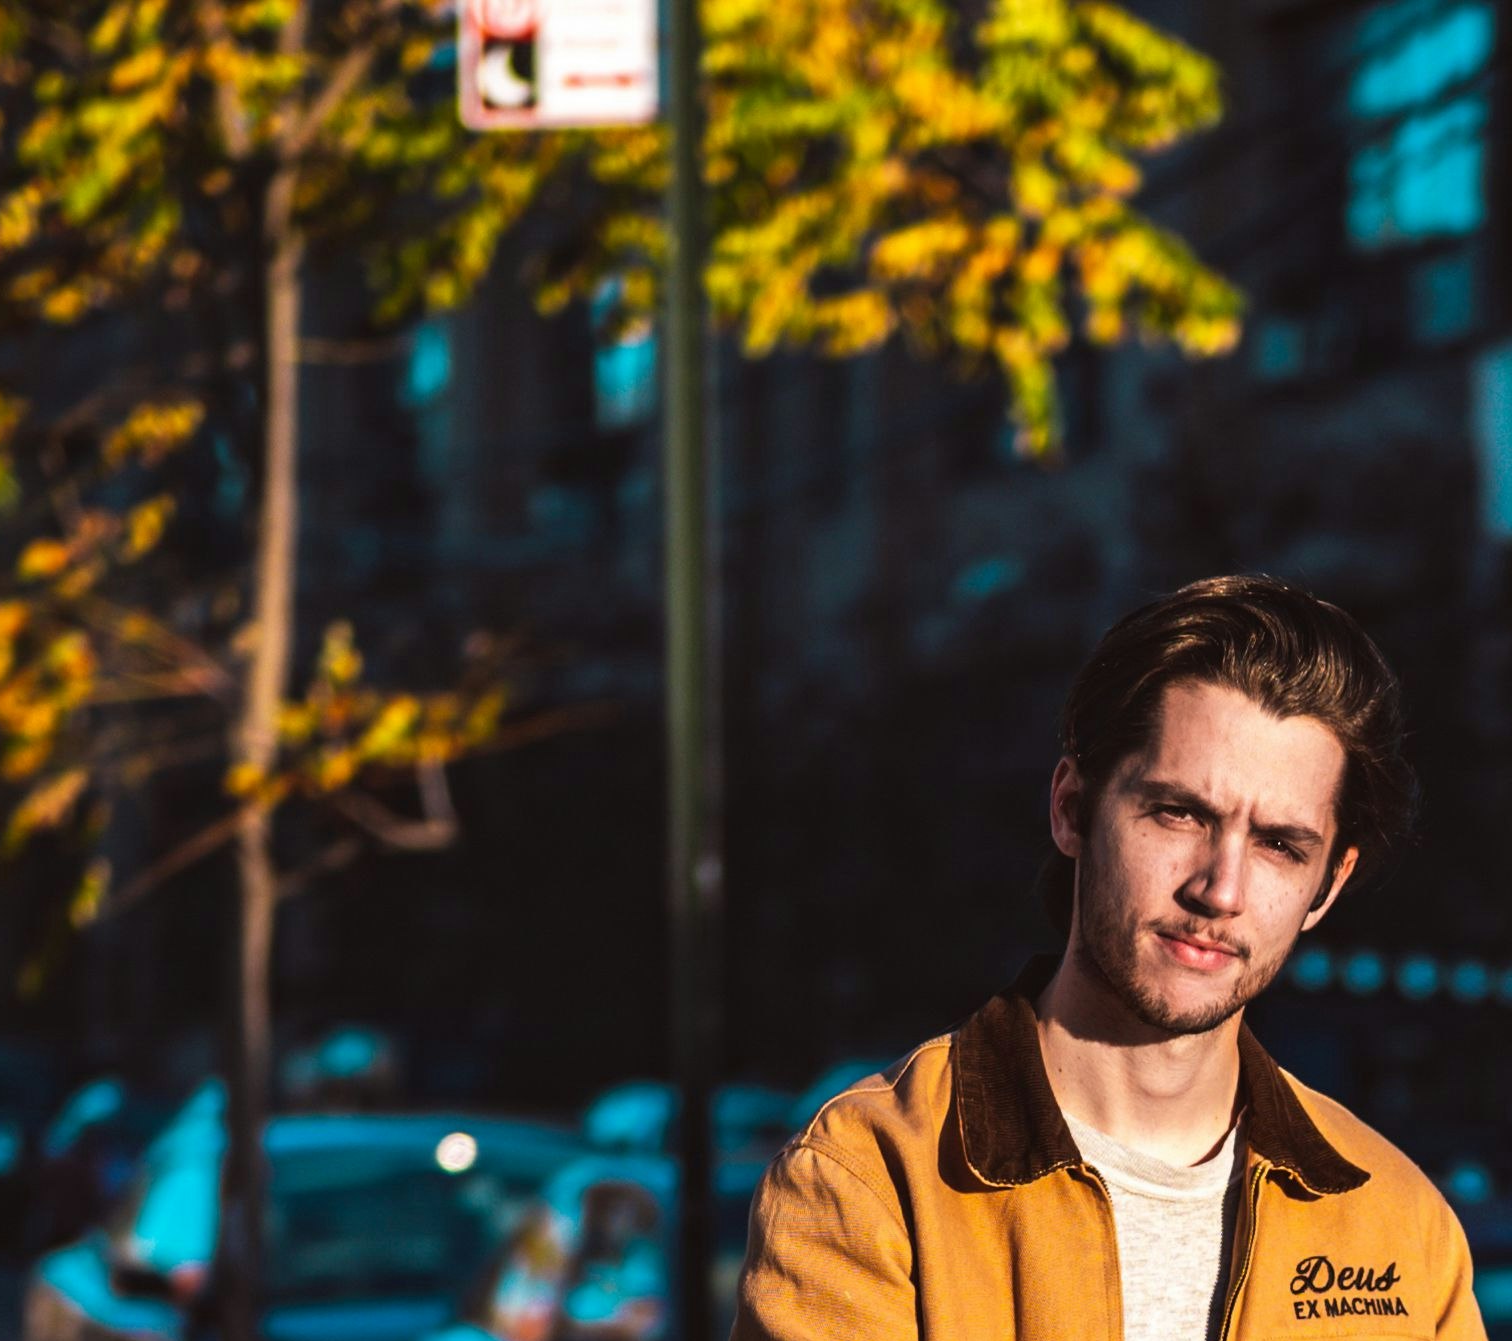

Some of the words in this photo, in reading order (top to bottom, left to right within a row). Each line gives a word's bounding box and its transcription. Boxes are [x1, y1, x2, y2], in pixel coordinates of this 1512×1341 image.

[1290, 1255, 1401, 1296] Deus
[1293, 1299, 1321, 1320] EX
[1324, 1296, 1409, 1319] MACHINA
